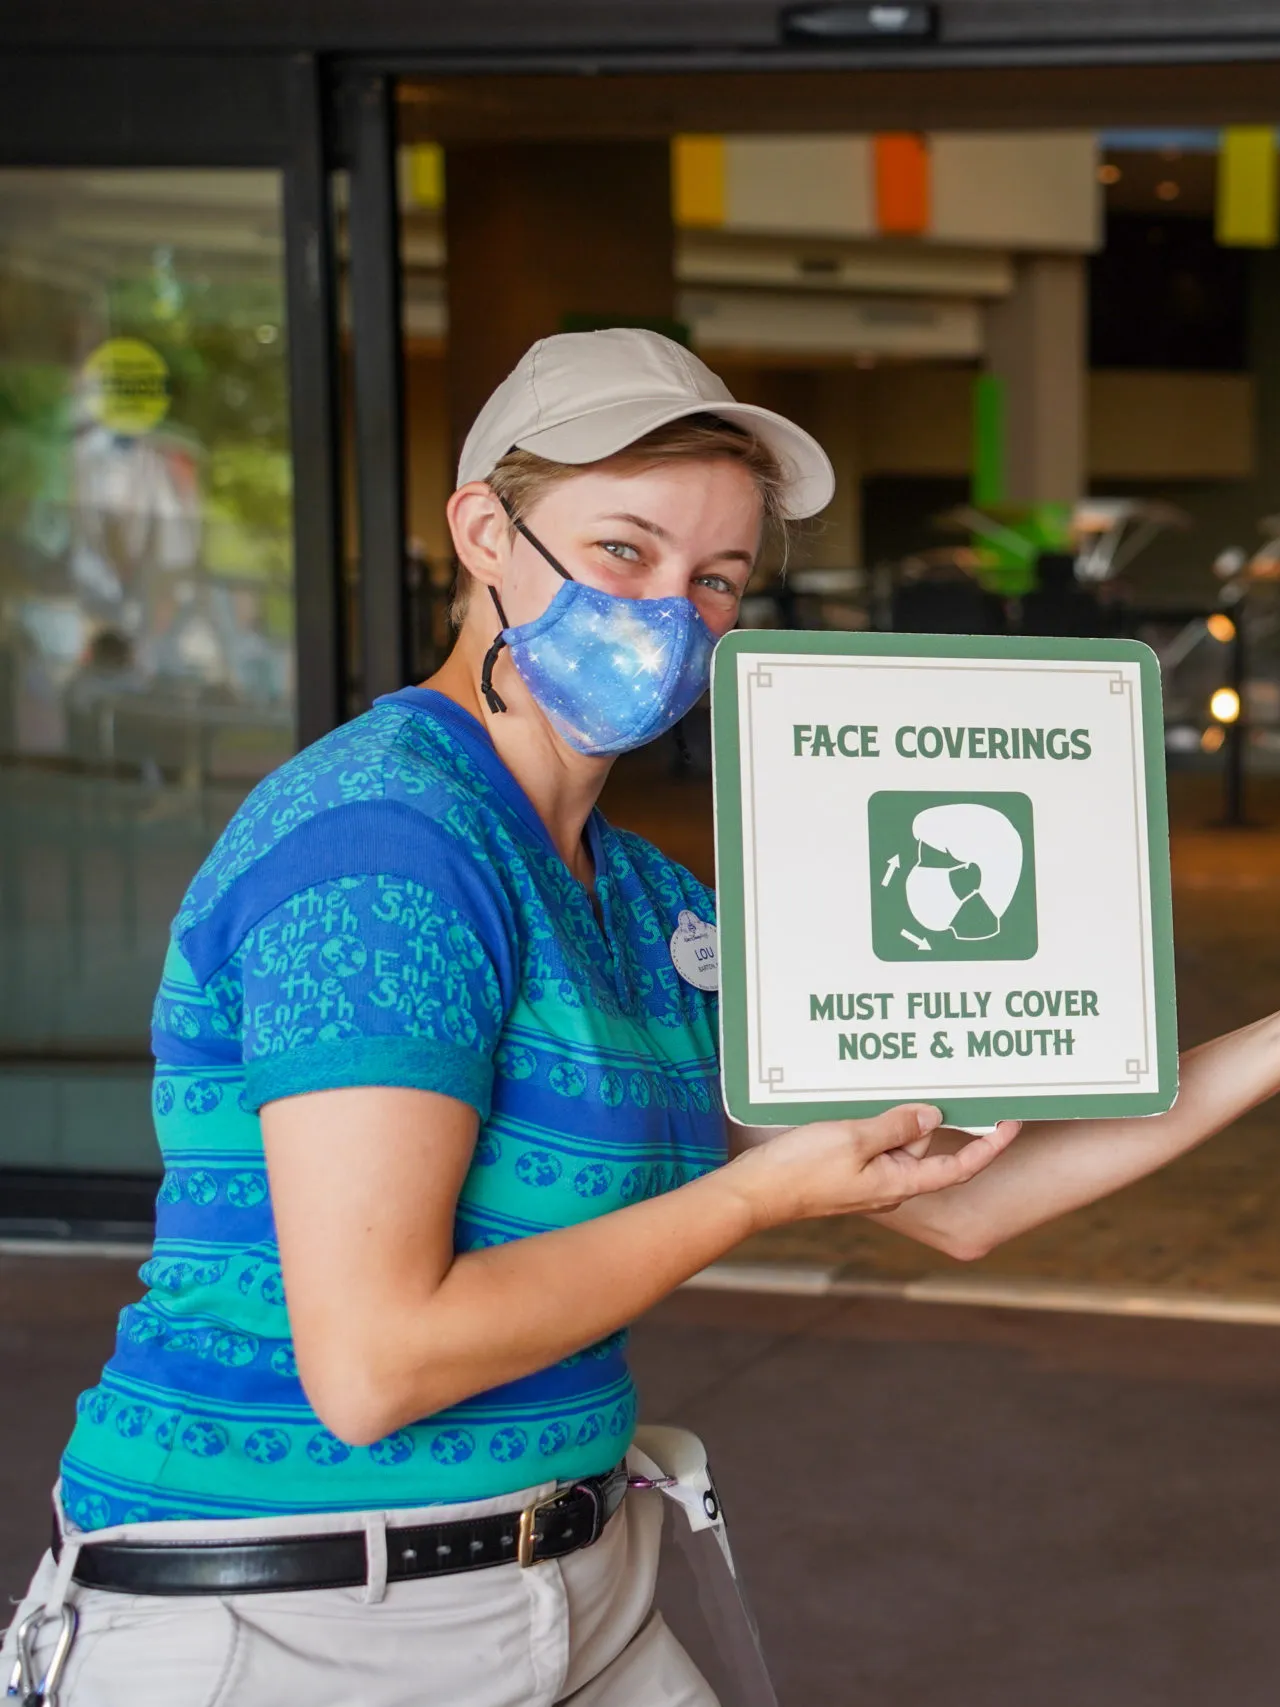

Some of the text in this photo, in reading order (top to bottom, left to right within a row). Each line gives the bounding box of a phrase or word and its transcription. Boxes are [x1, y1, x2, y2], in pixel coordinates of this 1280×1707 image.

[793, 724, 1092, 761] FACE COVERINGS
[694, 946, 715, 961] LOU
[809, 990, 1100, 1021] MUST FULLY COVER
[838, 1029, 1075, 1060] NOSE & MOUTH
